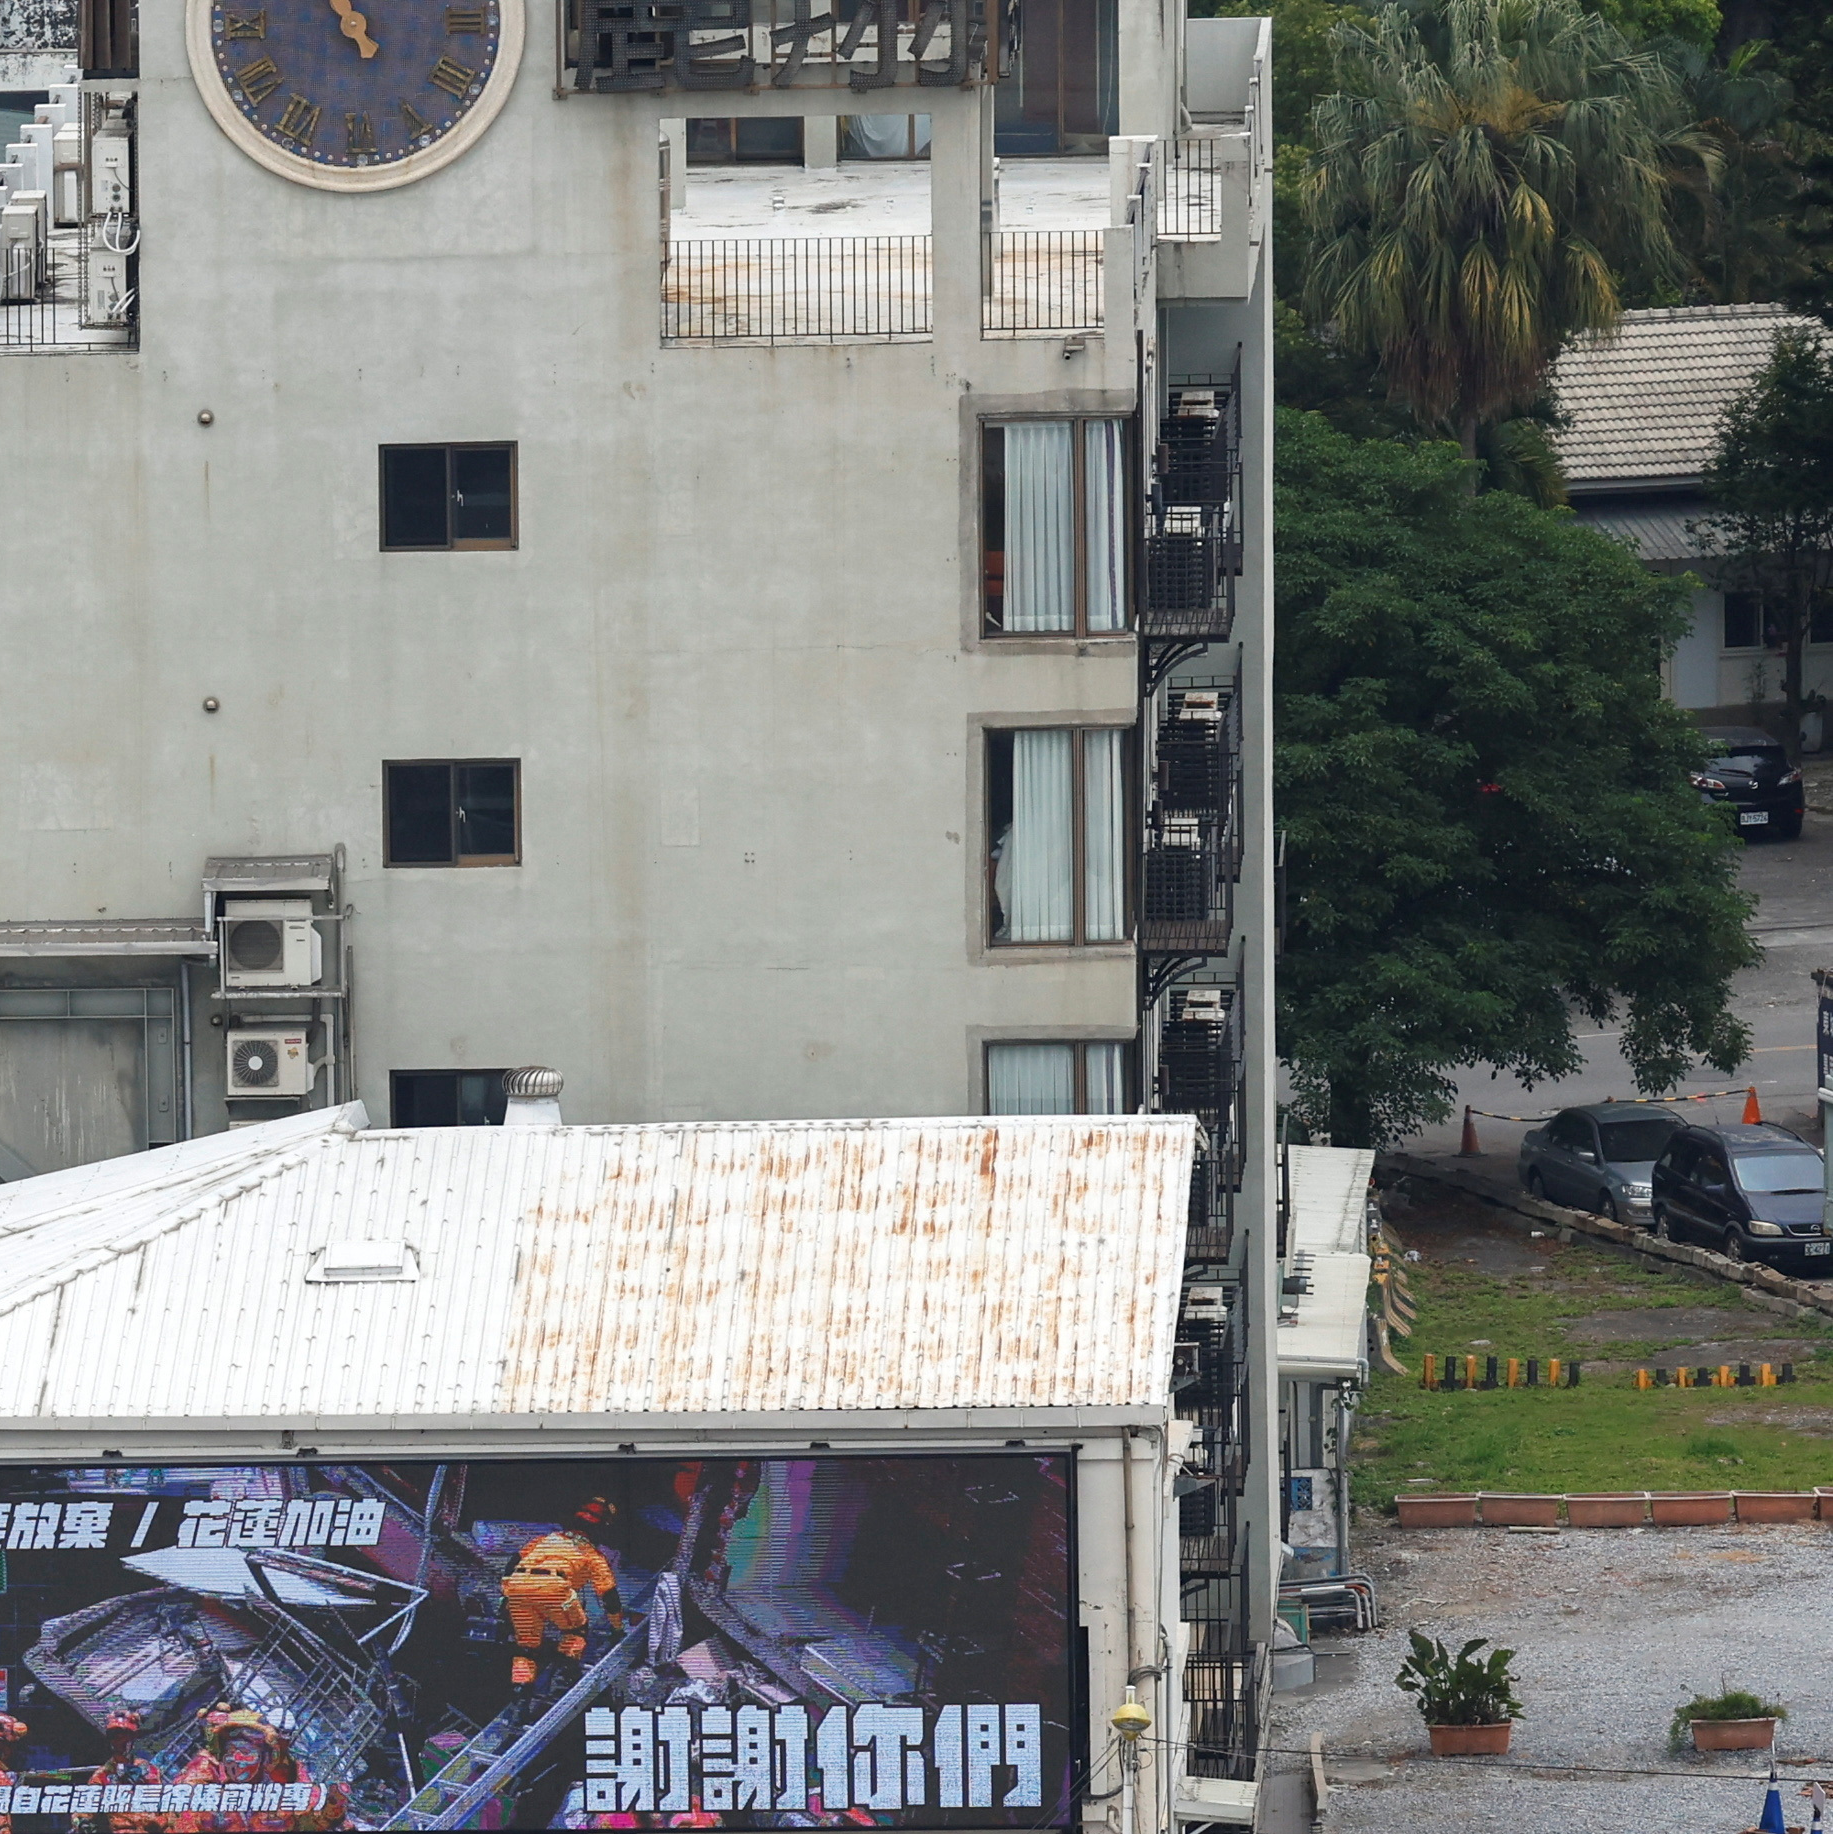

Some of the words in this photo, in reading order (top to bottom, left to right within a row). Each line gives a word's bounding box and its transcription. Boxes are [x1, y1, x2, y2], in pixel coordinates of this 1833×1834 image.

[177, 1498, 388, 1549] 花蓮加油
[584, 1703, 1042, 1812] 謝謝你們
